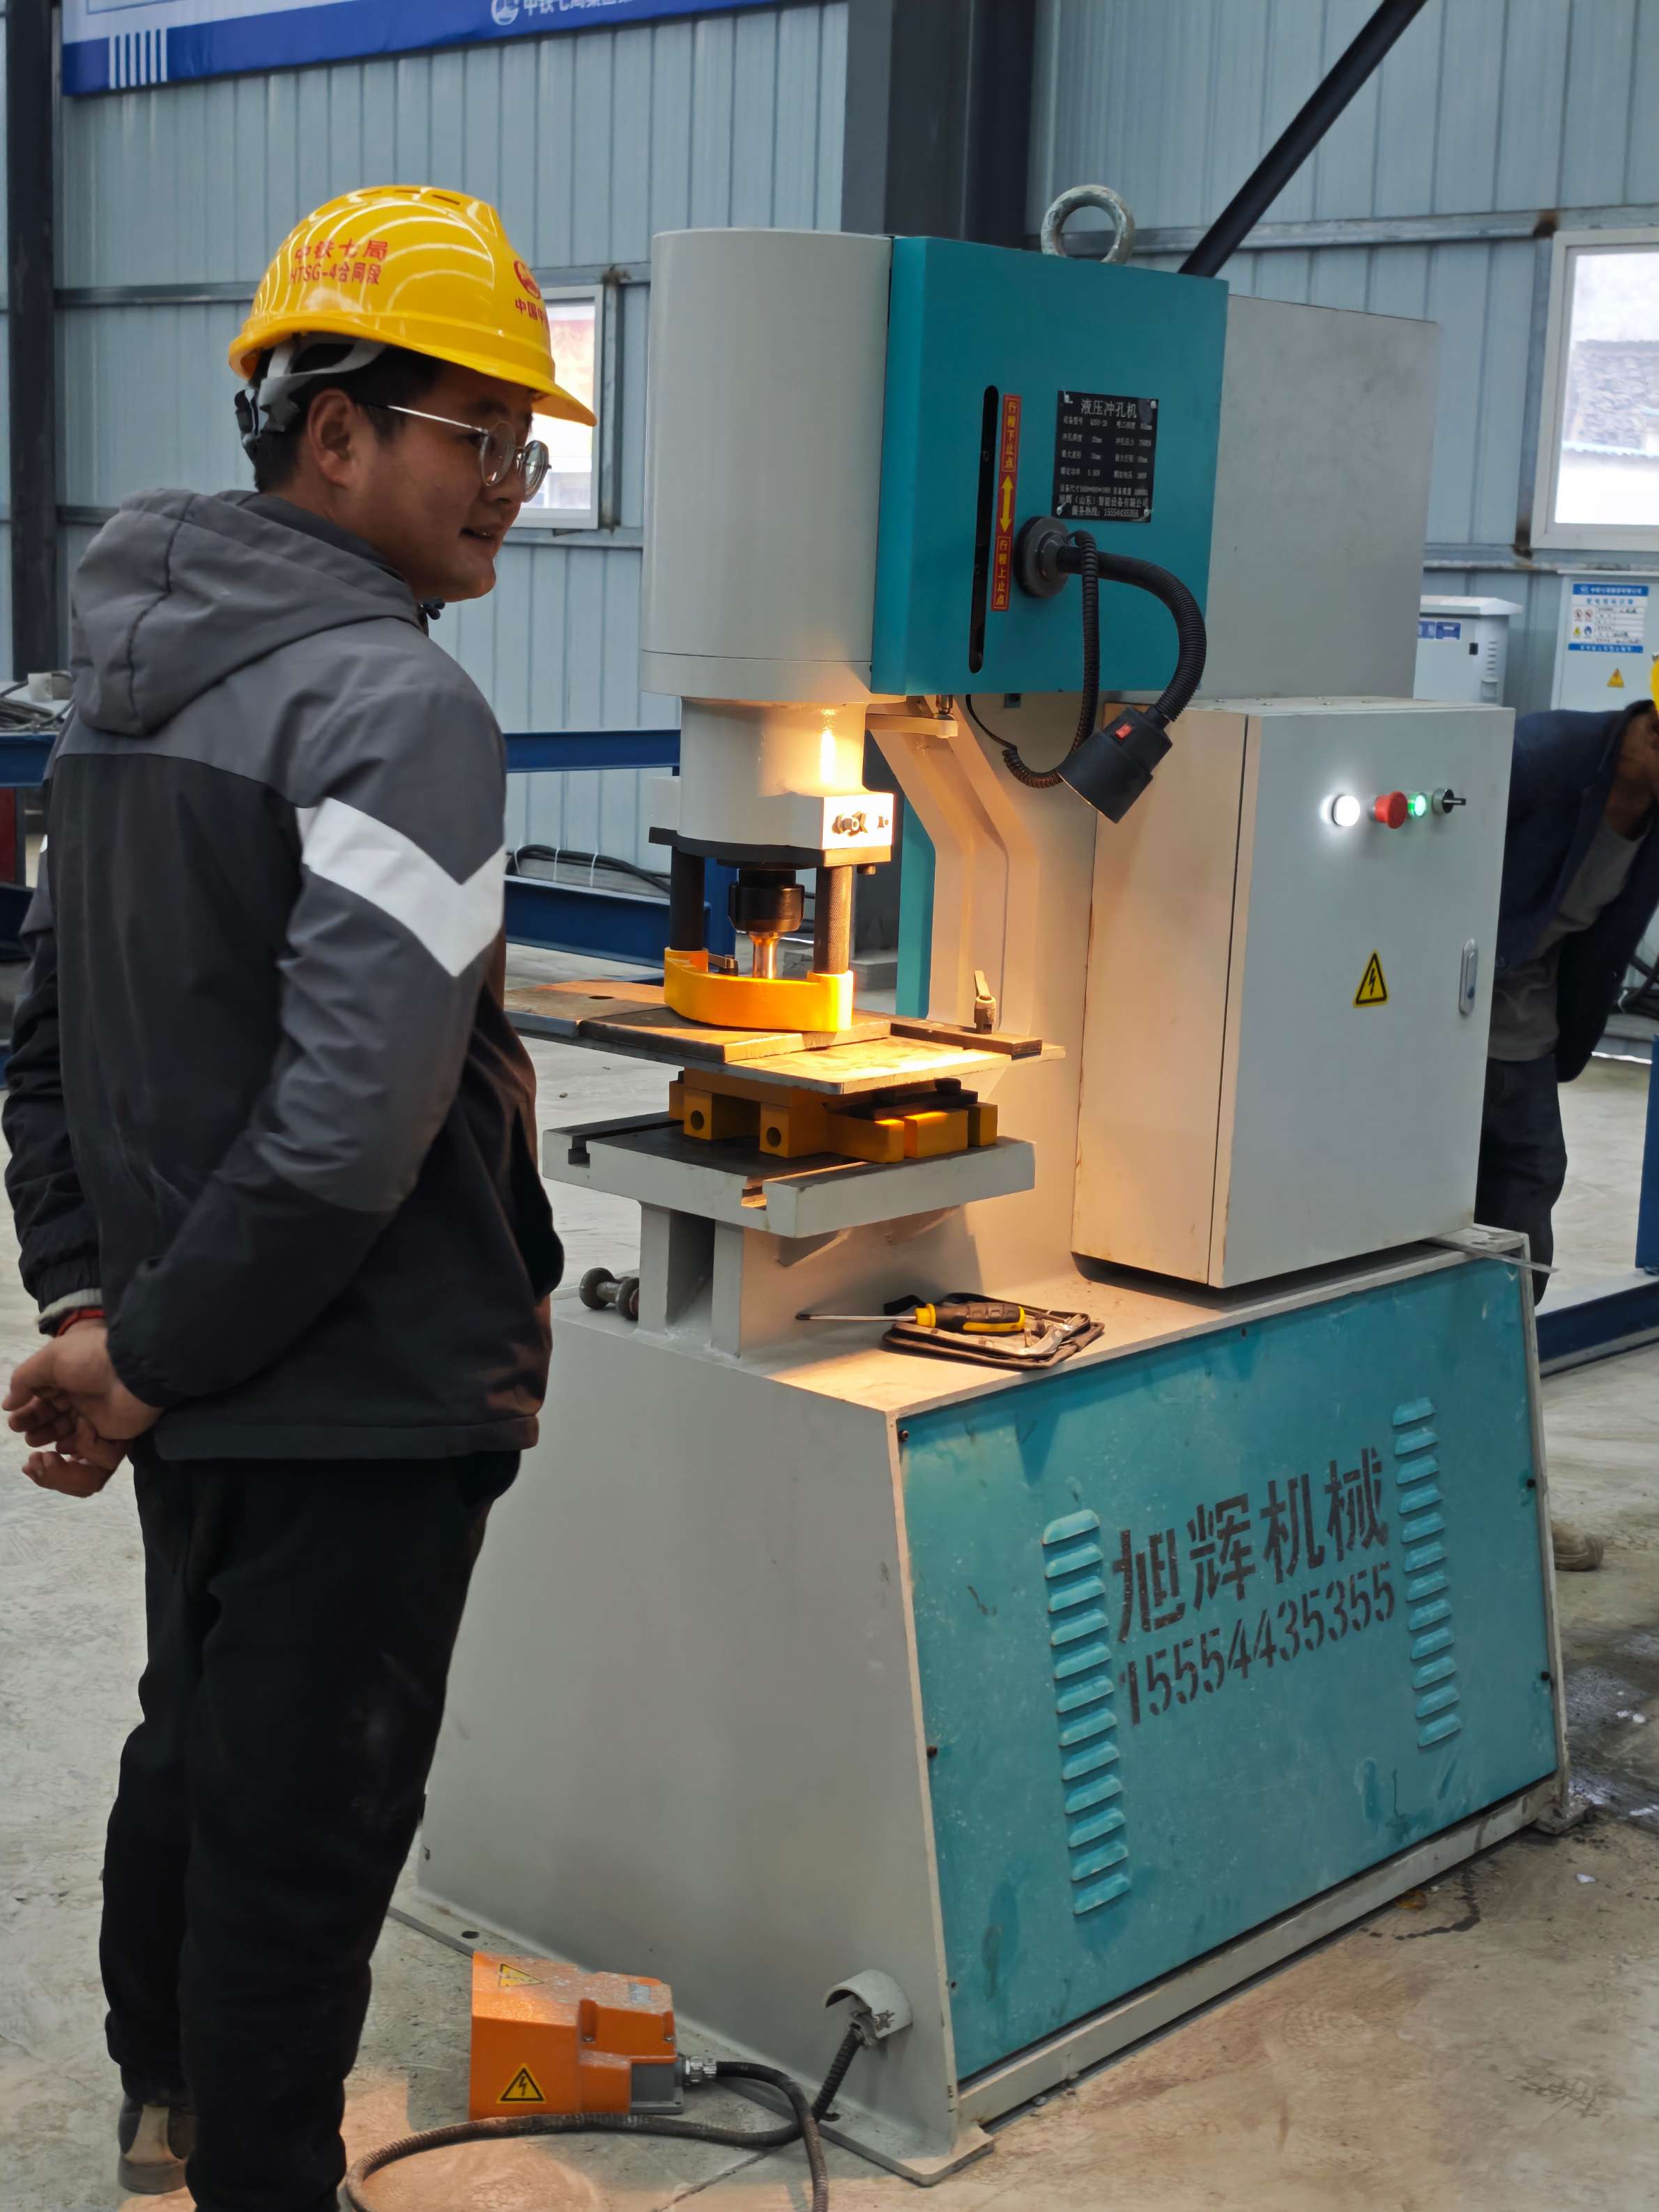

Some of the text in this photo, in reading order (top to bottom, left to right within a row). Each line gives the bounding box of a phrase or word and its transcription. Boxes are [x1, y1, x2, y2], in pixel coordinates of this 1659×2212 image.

[295, 238, 388, 261] 中铁七局
[1081, 398, 1138, 419] 液压冲孔机
[1112, 1447, 1391, 1643] 旭辉机械
[1119, 1561, 1396, 1726] 15554435355
